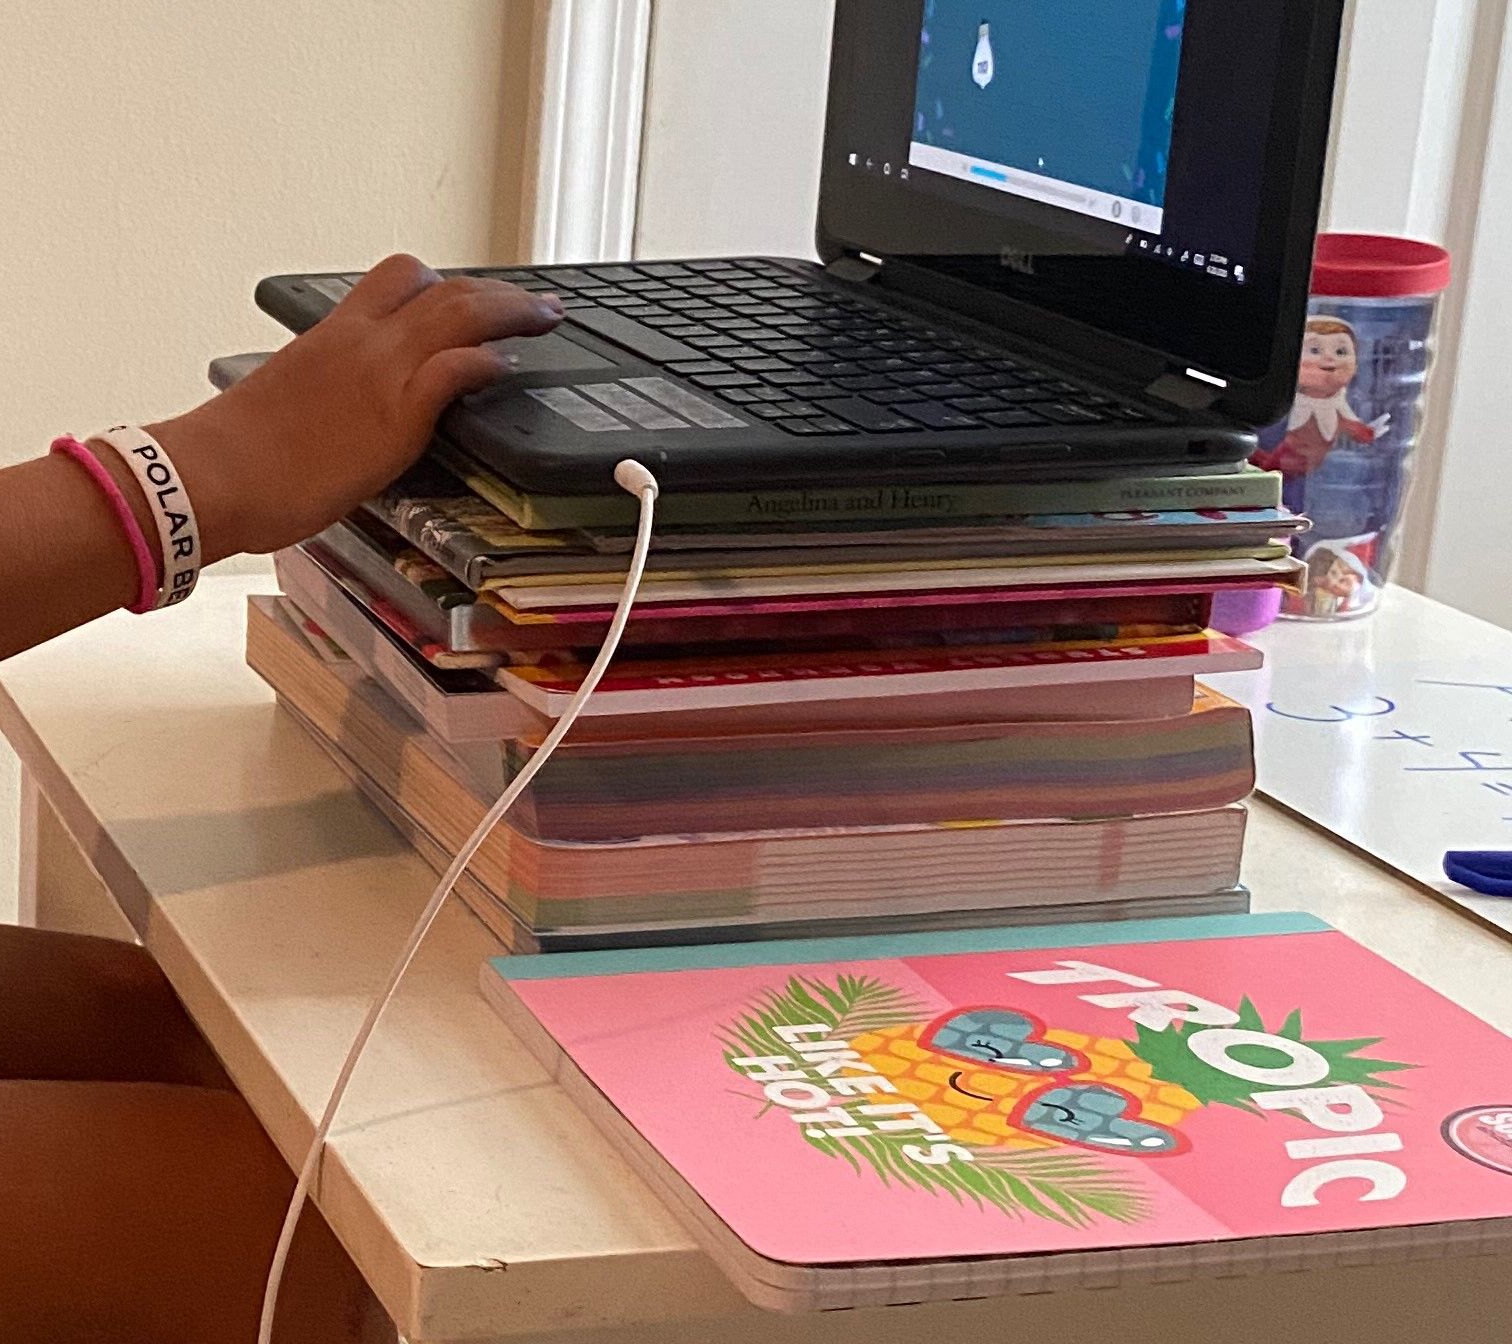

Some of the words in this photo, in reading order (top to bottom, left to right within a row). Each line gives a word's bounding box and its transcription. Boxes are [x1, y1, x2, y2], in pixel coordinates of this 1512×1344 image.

[131, 444, 194, 561] POLAR
[746, 490, 840, 516] Angelina
[846, 489, 884, 511] and
[890, 487, 957, 514] Henry
[731, 1055, 874, 1140] HOT!
[771, 1022, 899, 1097] LIKE
[856, 1102, 976, 1166] IT'S
[1004, 959, 1407, 1209] TROPIC
